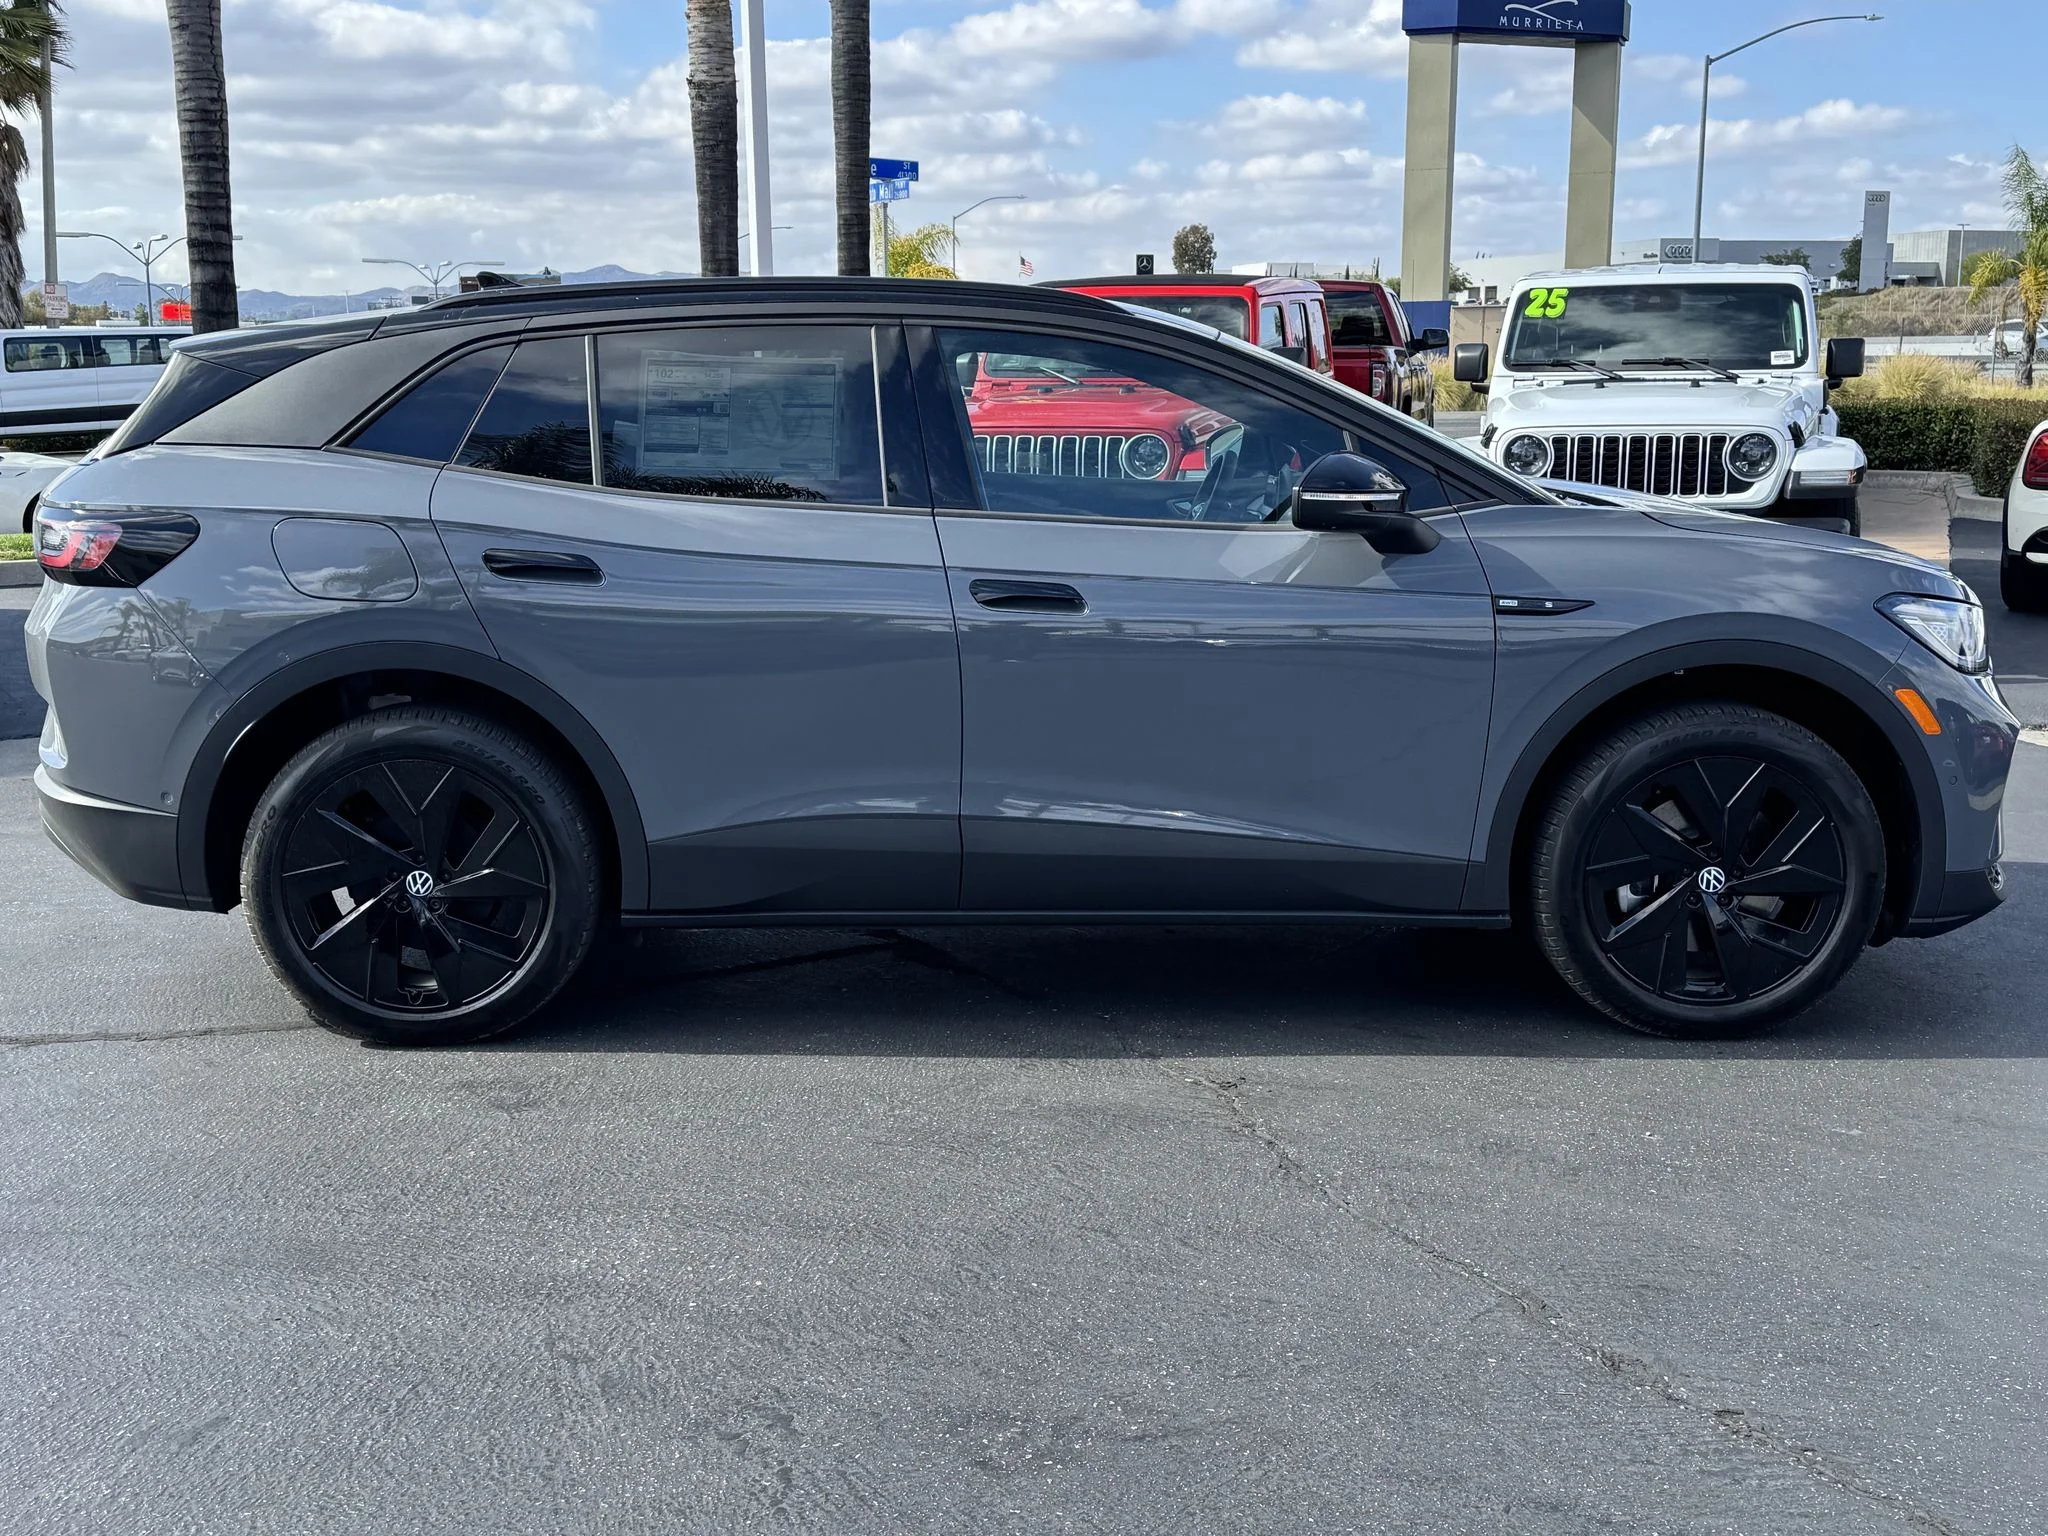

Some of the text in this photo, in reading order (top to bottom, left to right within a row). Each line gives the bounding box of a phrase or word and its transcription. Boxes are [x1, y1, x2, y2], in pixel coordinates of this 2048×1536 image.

[1499, 16, 1584, 31] MURRIETA
[903, 161, 911, 170] ST
[880, 182, 894, 199] Mall
[46, 285, 55, 293] NO
[1524, 287, 1569, 318] 25
[655, 368, 674, 379] 102
